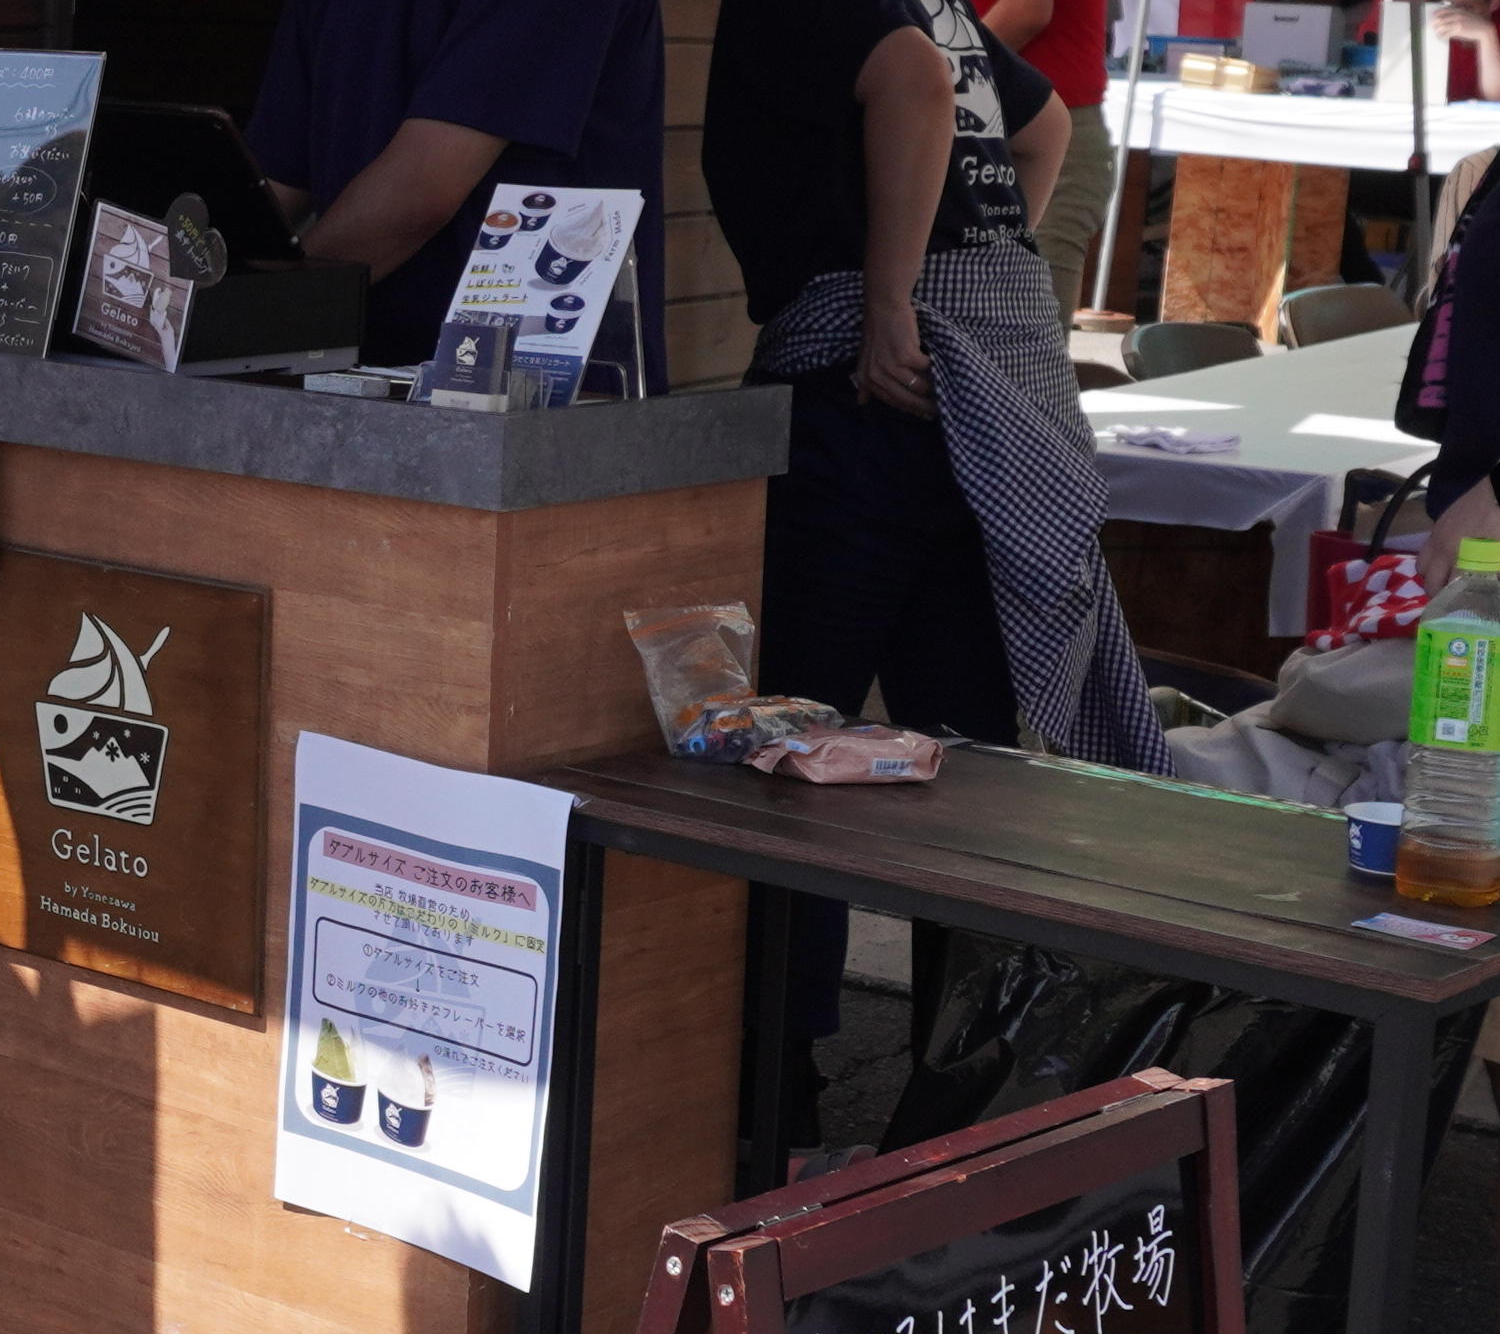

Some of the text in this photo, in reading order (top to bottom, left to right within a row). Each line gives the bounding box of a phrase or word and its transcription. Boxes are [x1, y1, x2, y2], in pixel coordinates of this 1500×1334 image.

[100, 302, 139, 327] Gelato
[51, 828, 150, 879] Gelato
[327, 837, 533, 908] ダブルサイズ ご注文のお客様へ
[40, 894, 160, 945] Hamada Bokujou
[63, 881, 137, 913] by Yonezawa
